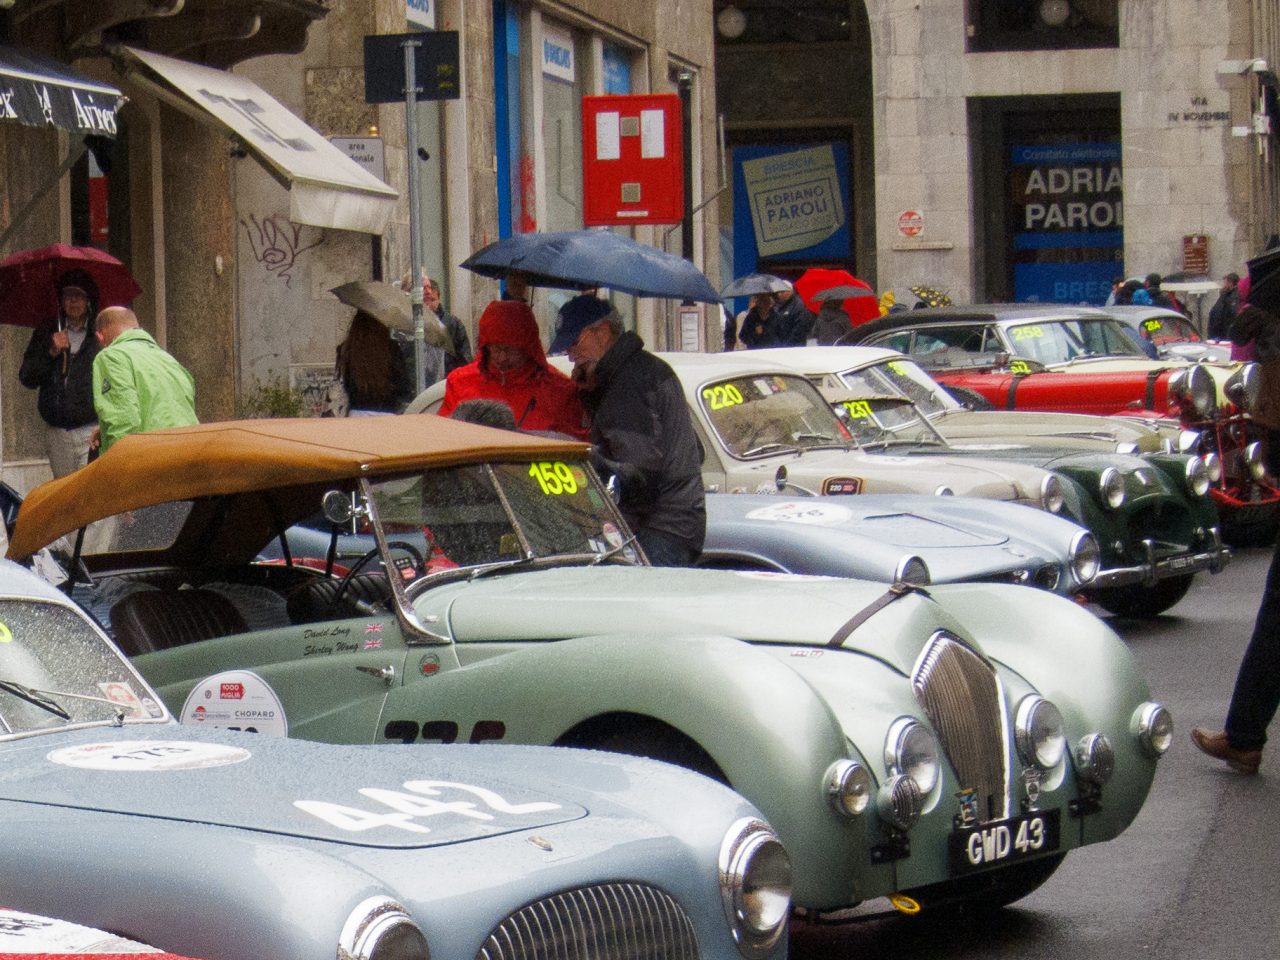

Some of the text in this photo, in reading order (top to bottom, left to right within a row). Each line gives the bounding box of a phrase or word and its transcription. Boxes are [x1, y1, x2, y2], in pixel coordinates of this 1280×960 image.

[1190, 96, 1208, 106] VIA
[765, 185, 824, 207] ADRIANO
[767, 199, 827, 223] PAROLI
[702, 383, 744, 411] 220
[843, 401, 873, 419] 237
[529, 461, 577, 495] 159
[222, 683, 240, 691] 1000
[234, 710, 275, 718] CHOPARD
[292, 779, 563, 834] 442
[967, 817, 1044, 865] GWD 43
